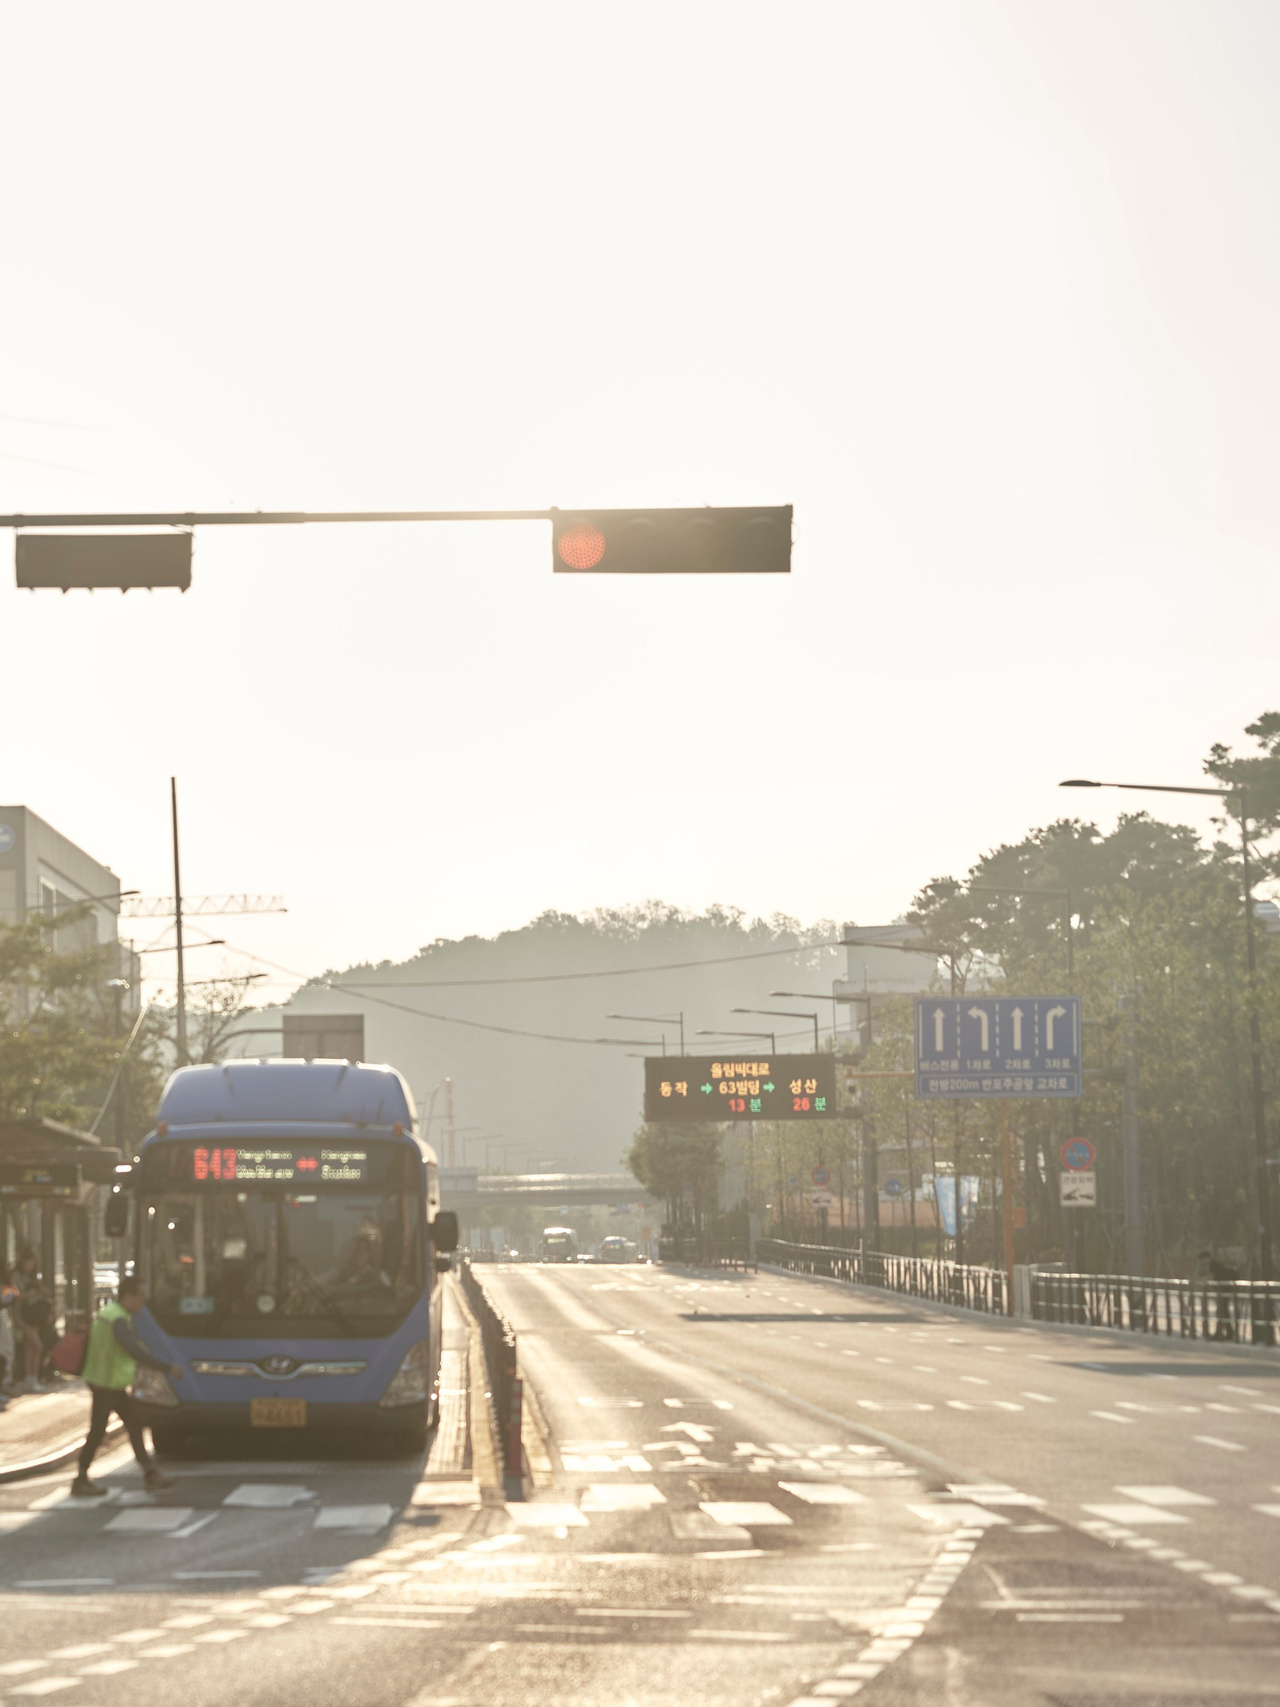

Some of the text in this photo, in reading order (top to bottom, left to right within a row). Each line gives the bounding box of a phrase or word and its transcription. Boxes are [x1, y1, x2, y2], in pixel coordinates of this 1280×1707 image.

[710, 1062, 770, 1079] 올림픽대로
[919, 1057, 1070, 1071] 버스전용 1차로 2차로 3차로
[1036, 1077, 1069, 1090] 교차로
[193, 1147, 237, 1180] 643
